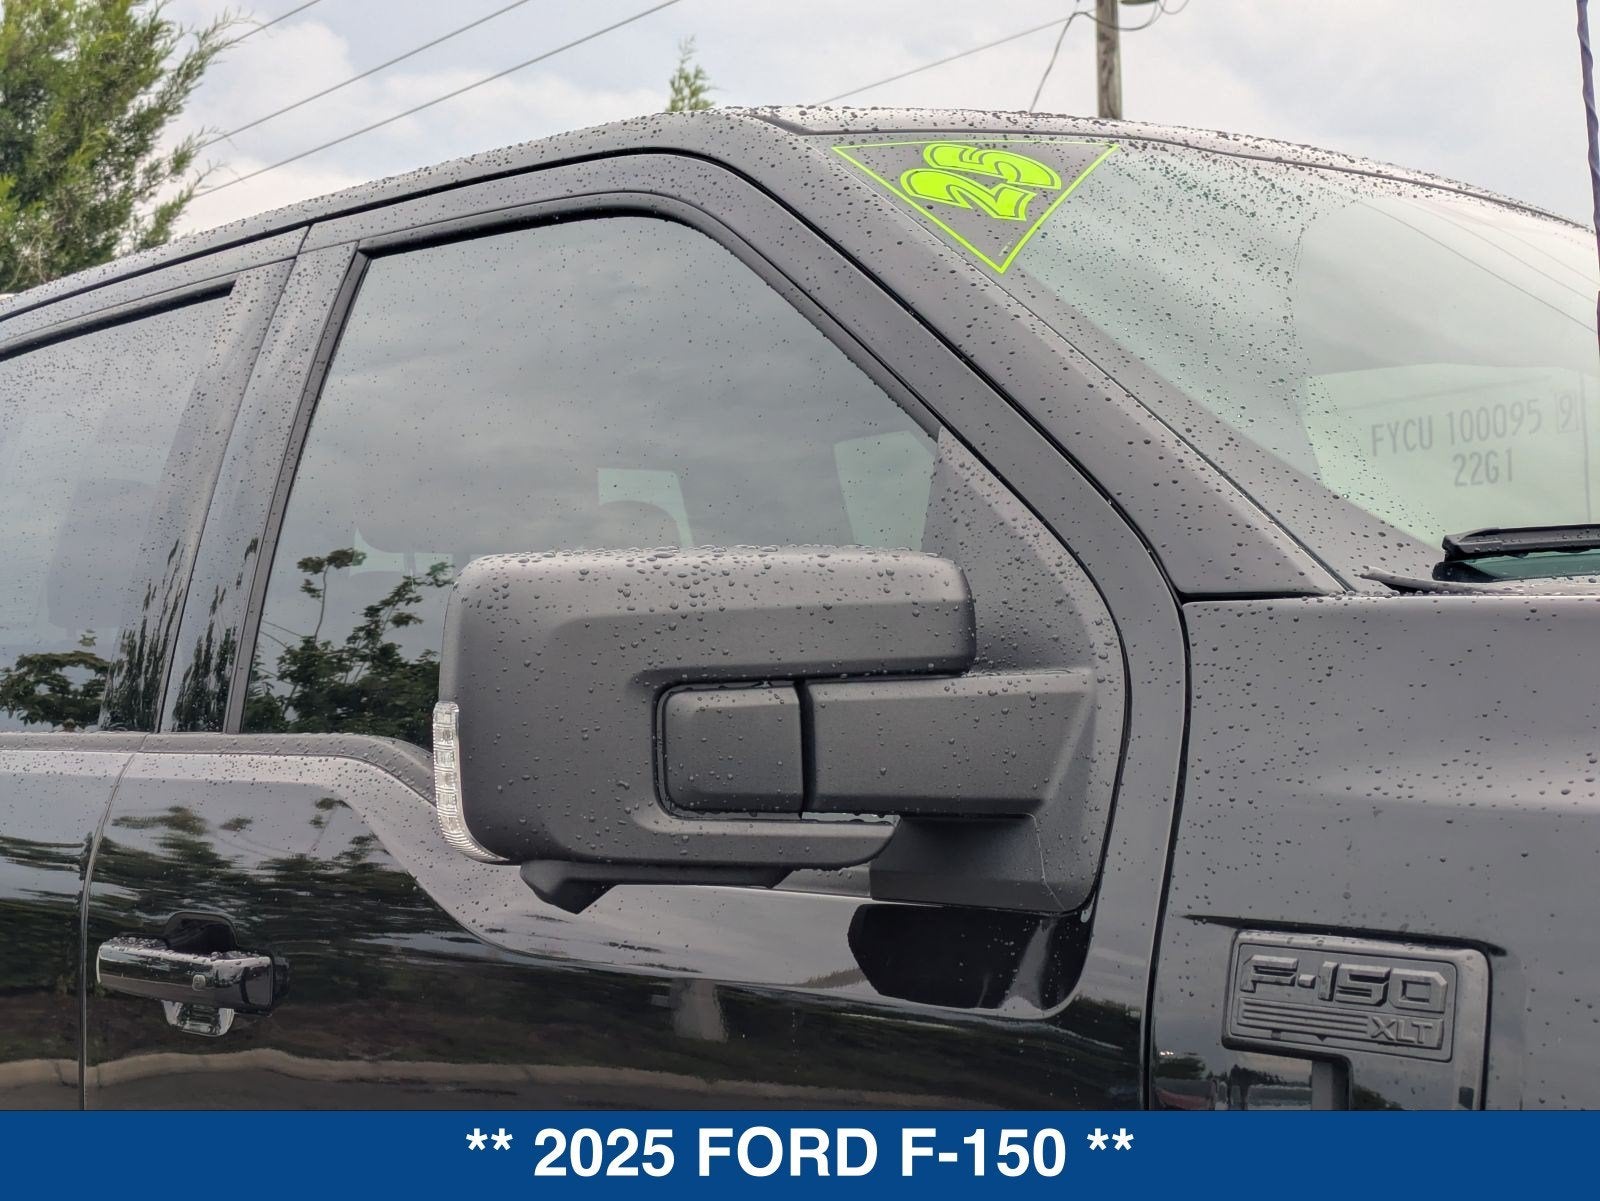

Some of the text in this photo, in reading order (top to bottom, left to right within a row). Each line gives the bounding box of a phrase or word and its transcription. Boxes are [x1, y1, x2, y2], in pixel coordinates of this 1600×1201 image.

[900, 143, 1062, 221] 25
[1371, 415, 1433, 457] FYCU
[1446, 399, 1541, 445] 100095
[1452, 448, 1513, 487] 22G1
[1240, 954, 1448, 1013] F-150
[1371, 1016, 1432, 1044] XLT
